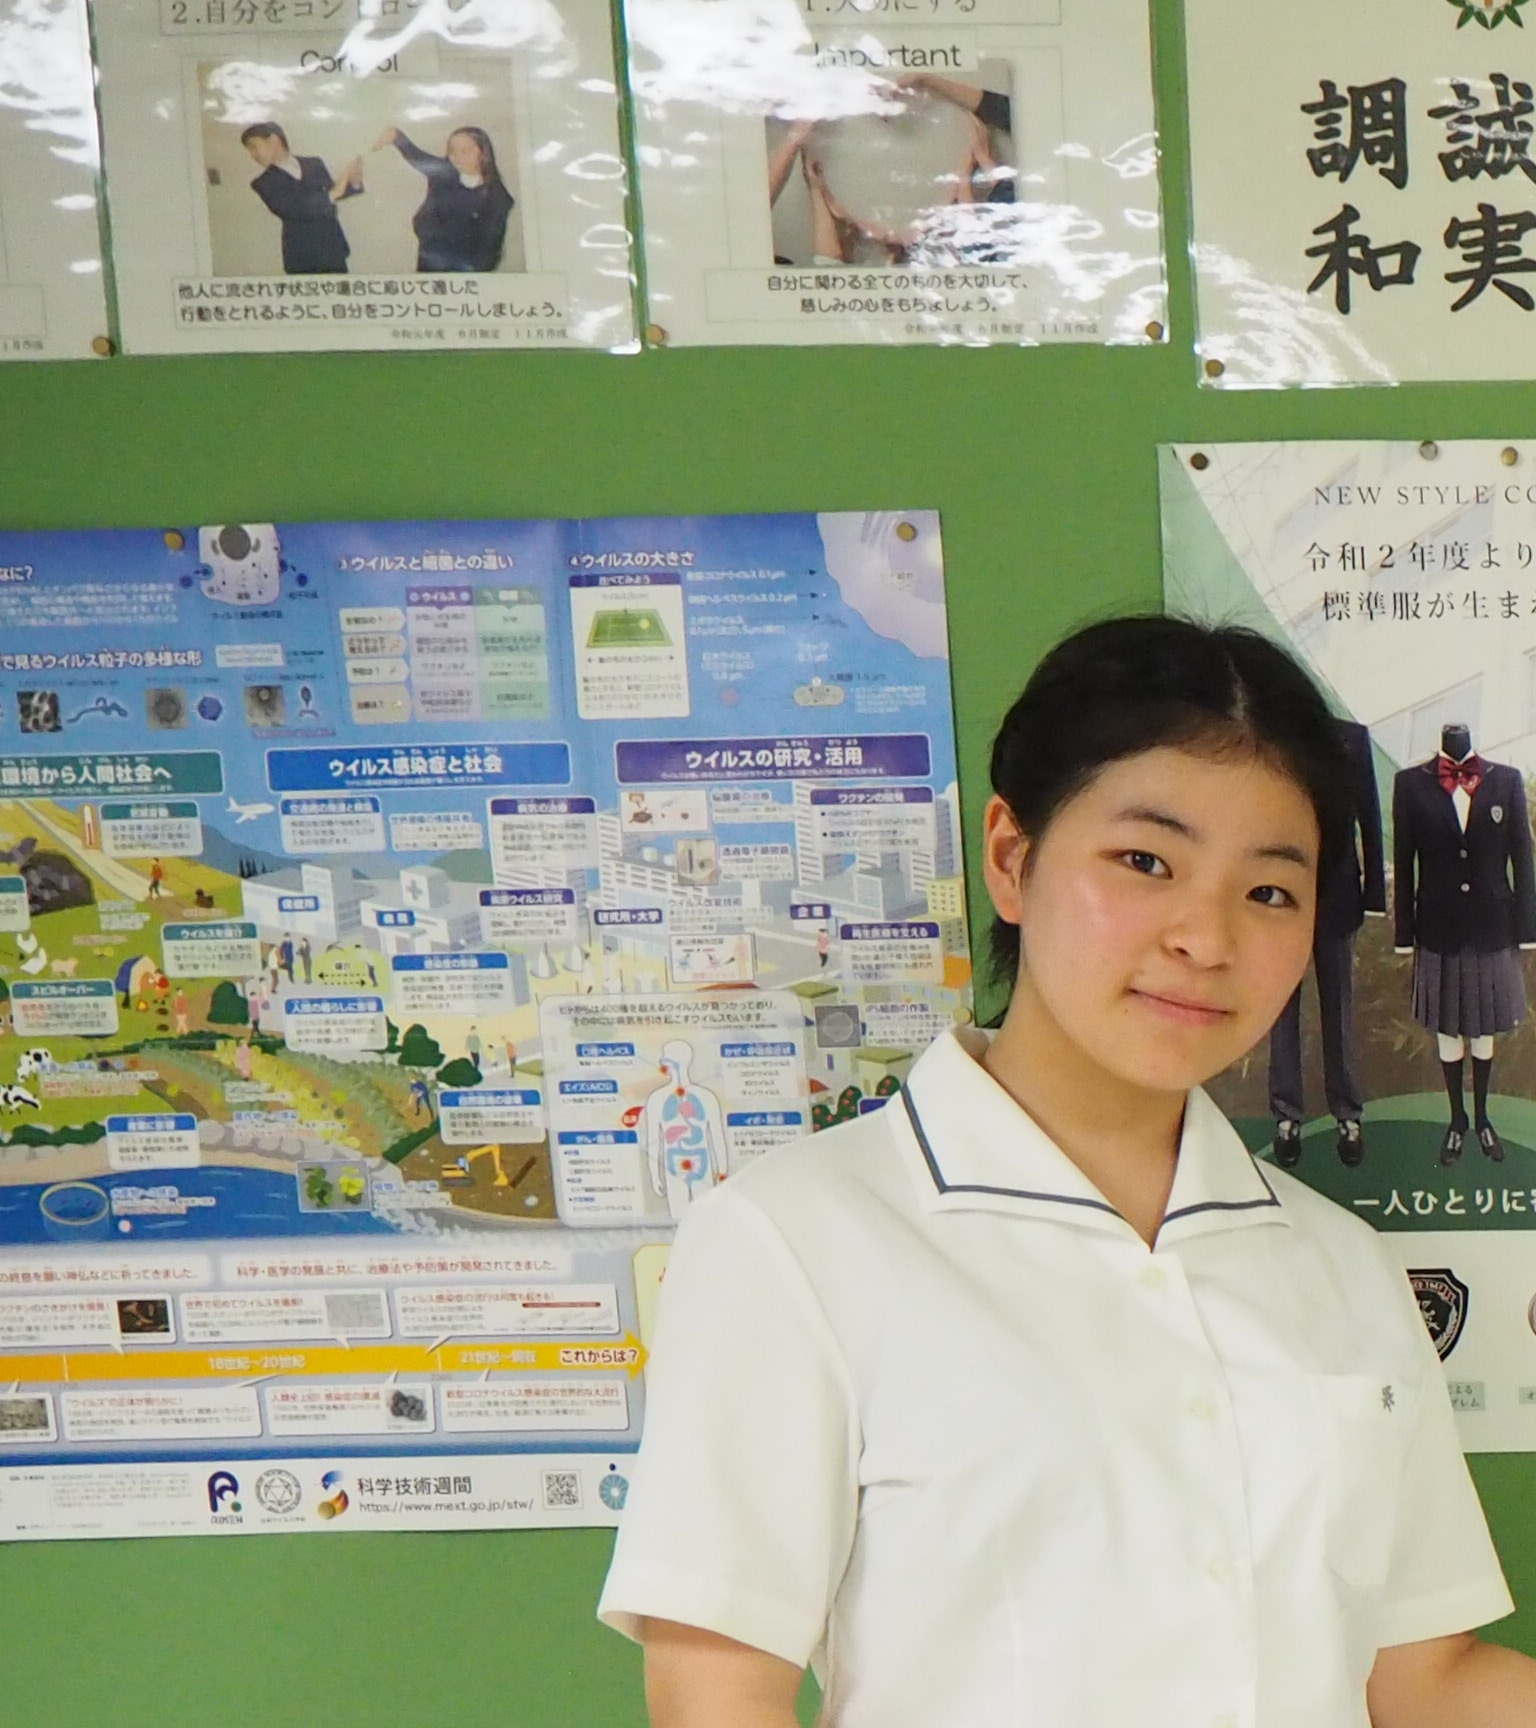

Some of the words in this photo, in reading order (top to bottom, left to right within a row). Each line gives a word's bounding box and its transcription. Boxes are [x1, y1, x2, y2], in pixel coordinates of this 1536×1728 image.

[1314, 485, 1381, 507] NEW
[1397, 484, 1491, 506] STYLE
[328, 755, 503, 777] ウイルス感染症と社会
[685, 746, 864, 769] ウイルスの研究・活用
[357, 1475, 473, 1497] 科学技術週間
[359, 1499, 535, 1514] https://www.mext.go.jp/stw/
